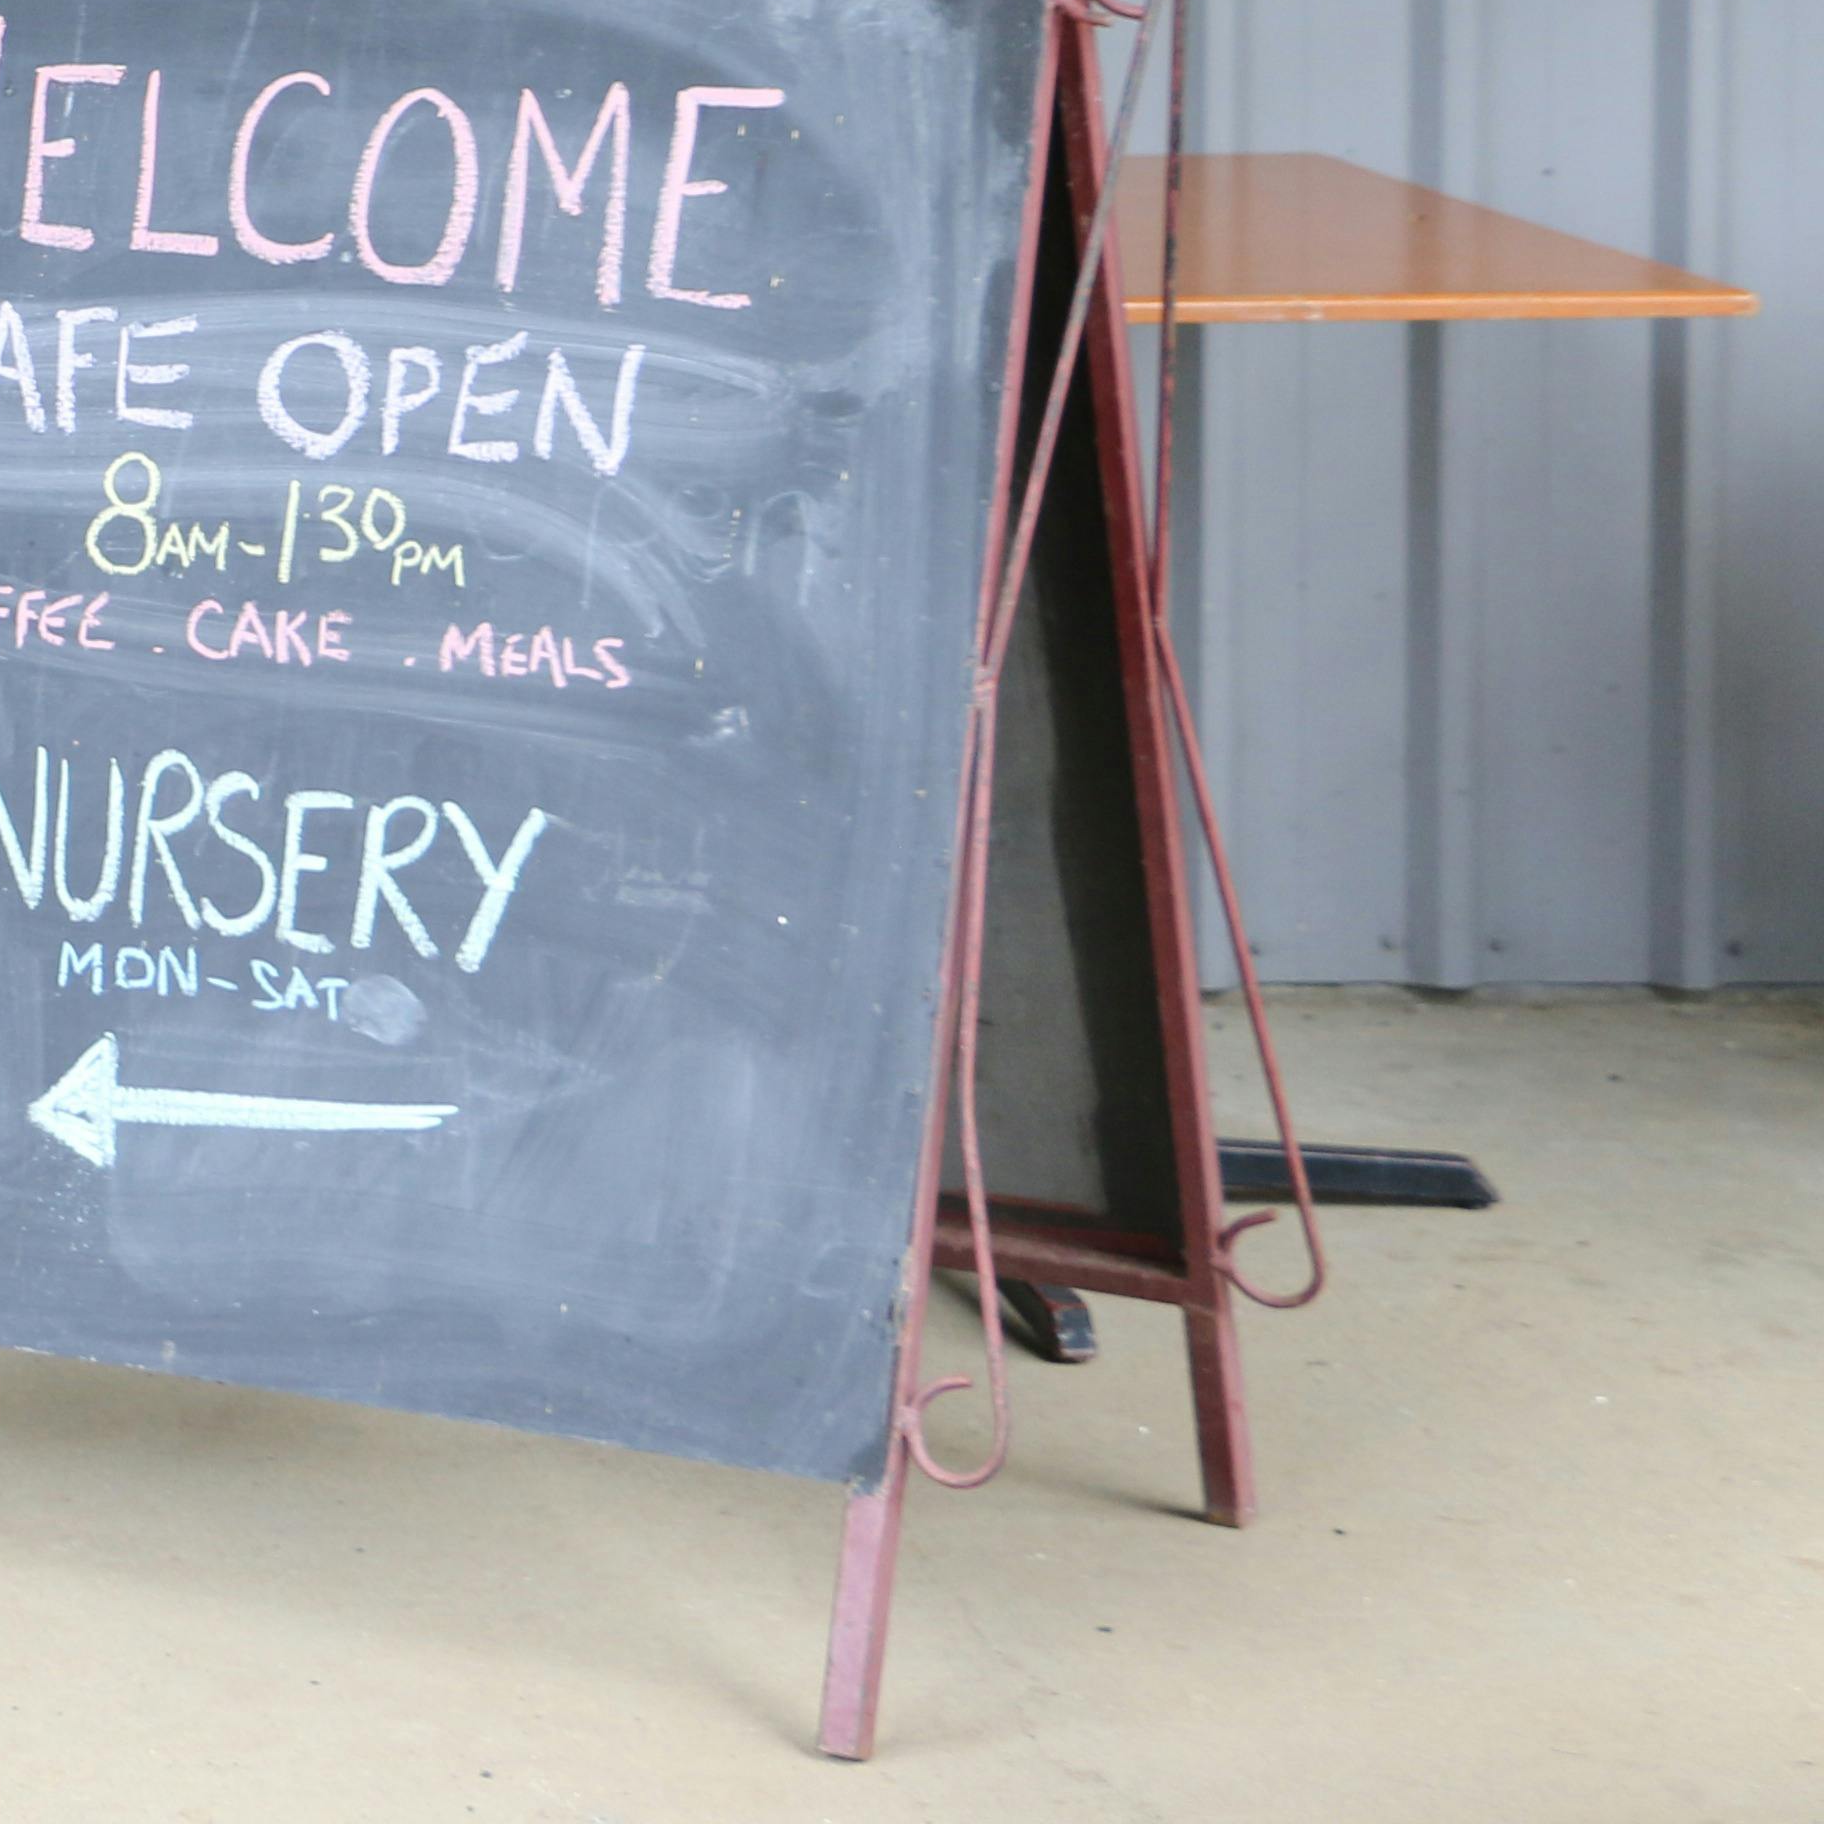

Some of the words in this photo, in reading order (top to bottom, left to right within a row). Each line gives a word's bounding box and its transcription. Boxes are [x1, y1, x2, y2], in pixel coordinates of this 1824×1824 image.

[256, 328, 647, 477] OPEN
[185, 597, 353, 667] CAKE
[438, 620, 632, 690] MEALS
